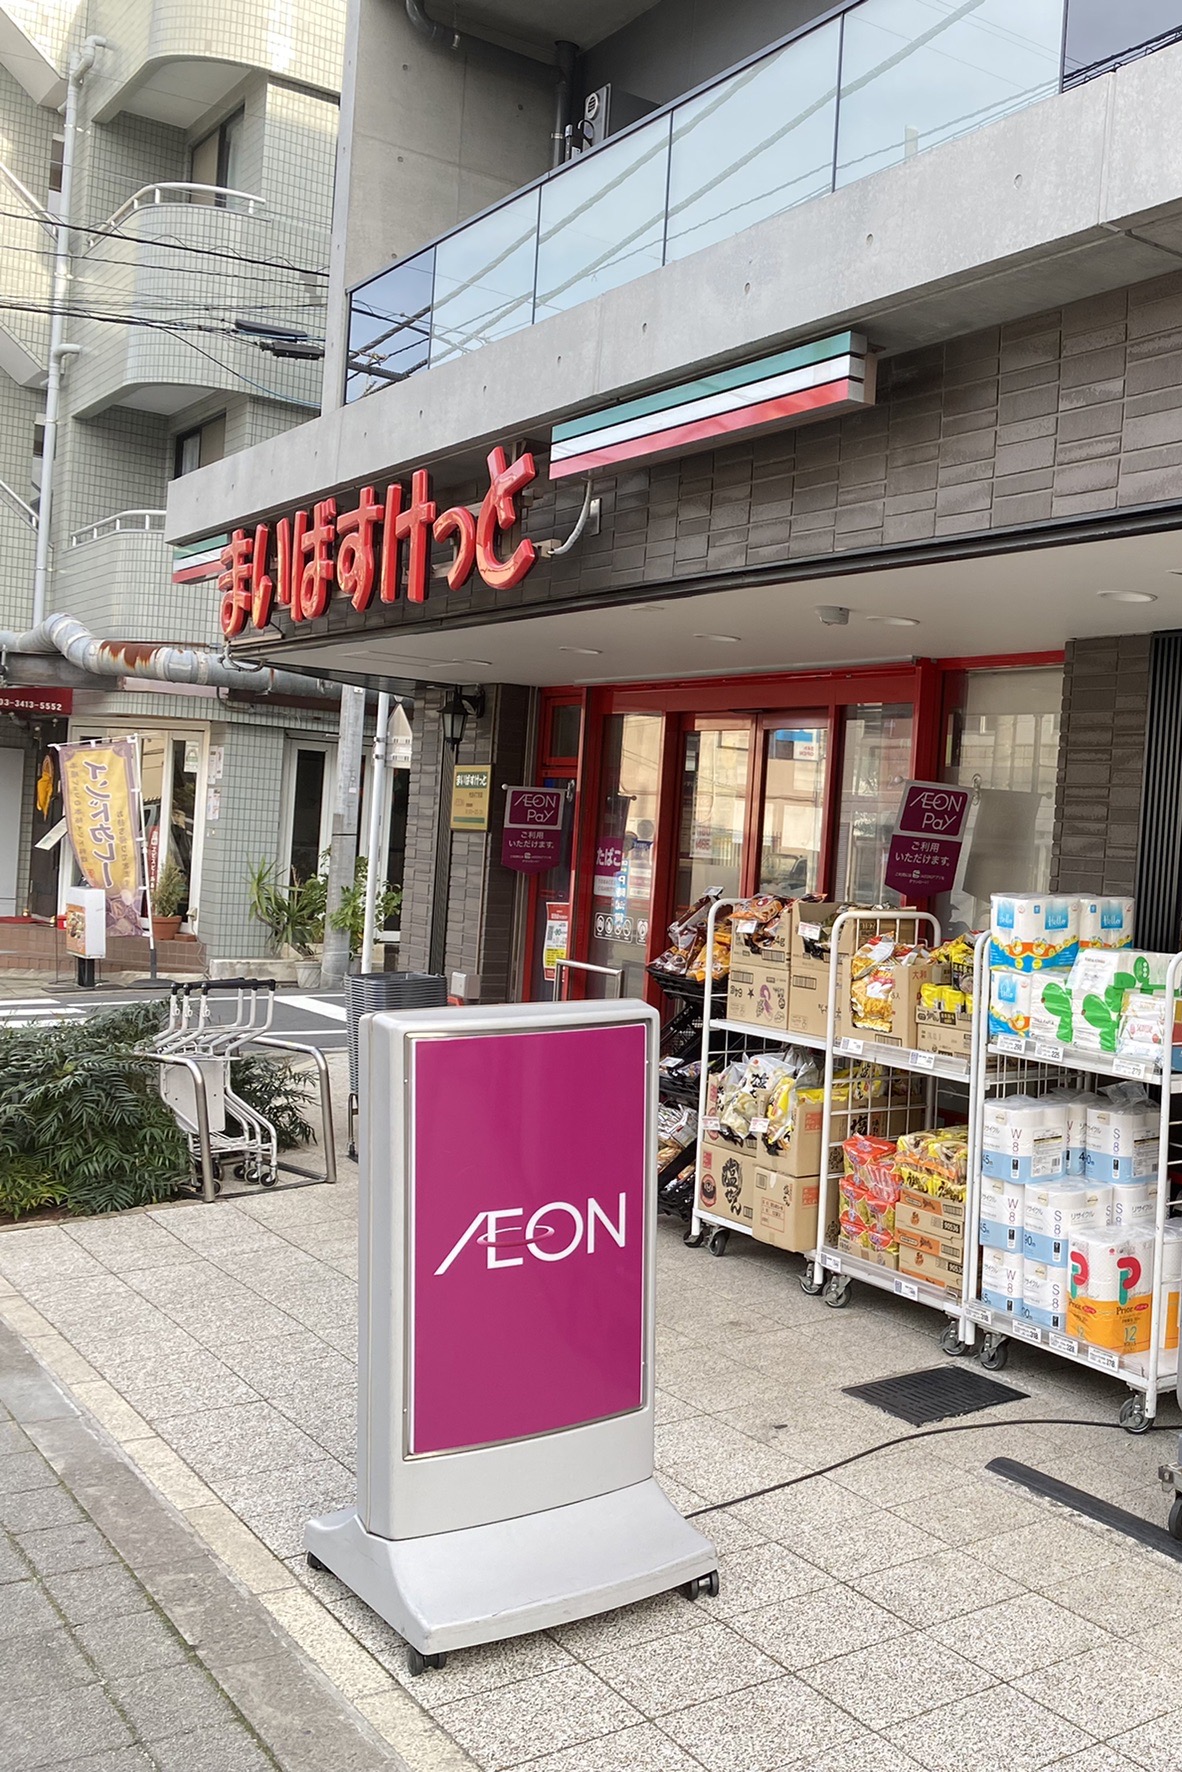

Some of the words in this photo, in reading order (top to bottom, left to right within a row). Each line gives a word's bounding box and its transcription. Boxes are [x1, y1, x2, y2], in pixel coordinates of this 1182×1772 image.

[218, 446, 536, 637] まいばすけっと
[456, 774, 487, 787] まいばすけっと
[520, 831, 544, 839] ご利用
[508, 840, 554, 849] いただけます。
[911, 841, 940, 852] ご利用
[596, 847, 622, 866] たばこ
[895, 852, 950, 867] いただけます。
[1048, 915, 1066, 927] Hello
[1103, 915, 1121, 925] Hello
[1113, 1128, 1121, 1140] S
[1012, 1141, 1019, 1152] 8
[1113, 1141, 1120, 1153] 8
[1009, 1211, 1016, 1223] 8
[1053, 1210, 1062, 1222] S
[1053, 1224, 1061, 1236] 8
[1006, 1282, 1014, 1294] 8
[1052, 1283, 1060, 1296] S
[1052, 1297, 1059, 1309] 8
[1124, 1325, 1138, 1342] 12
